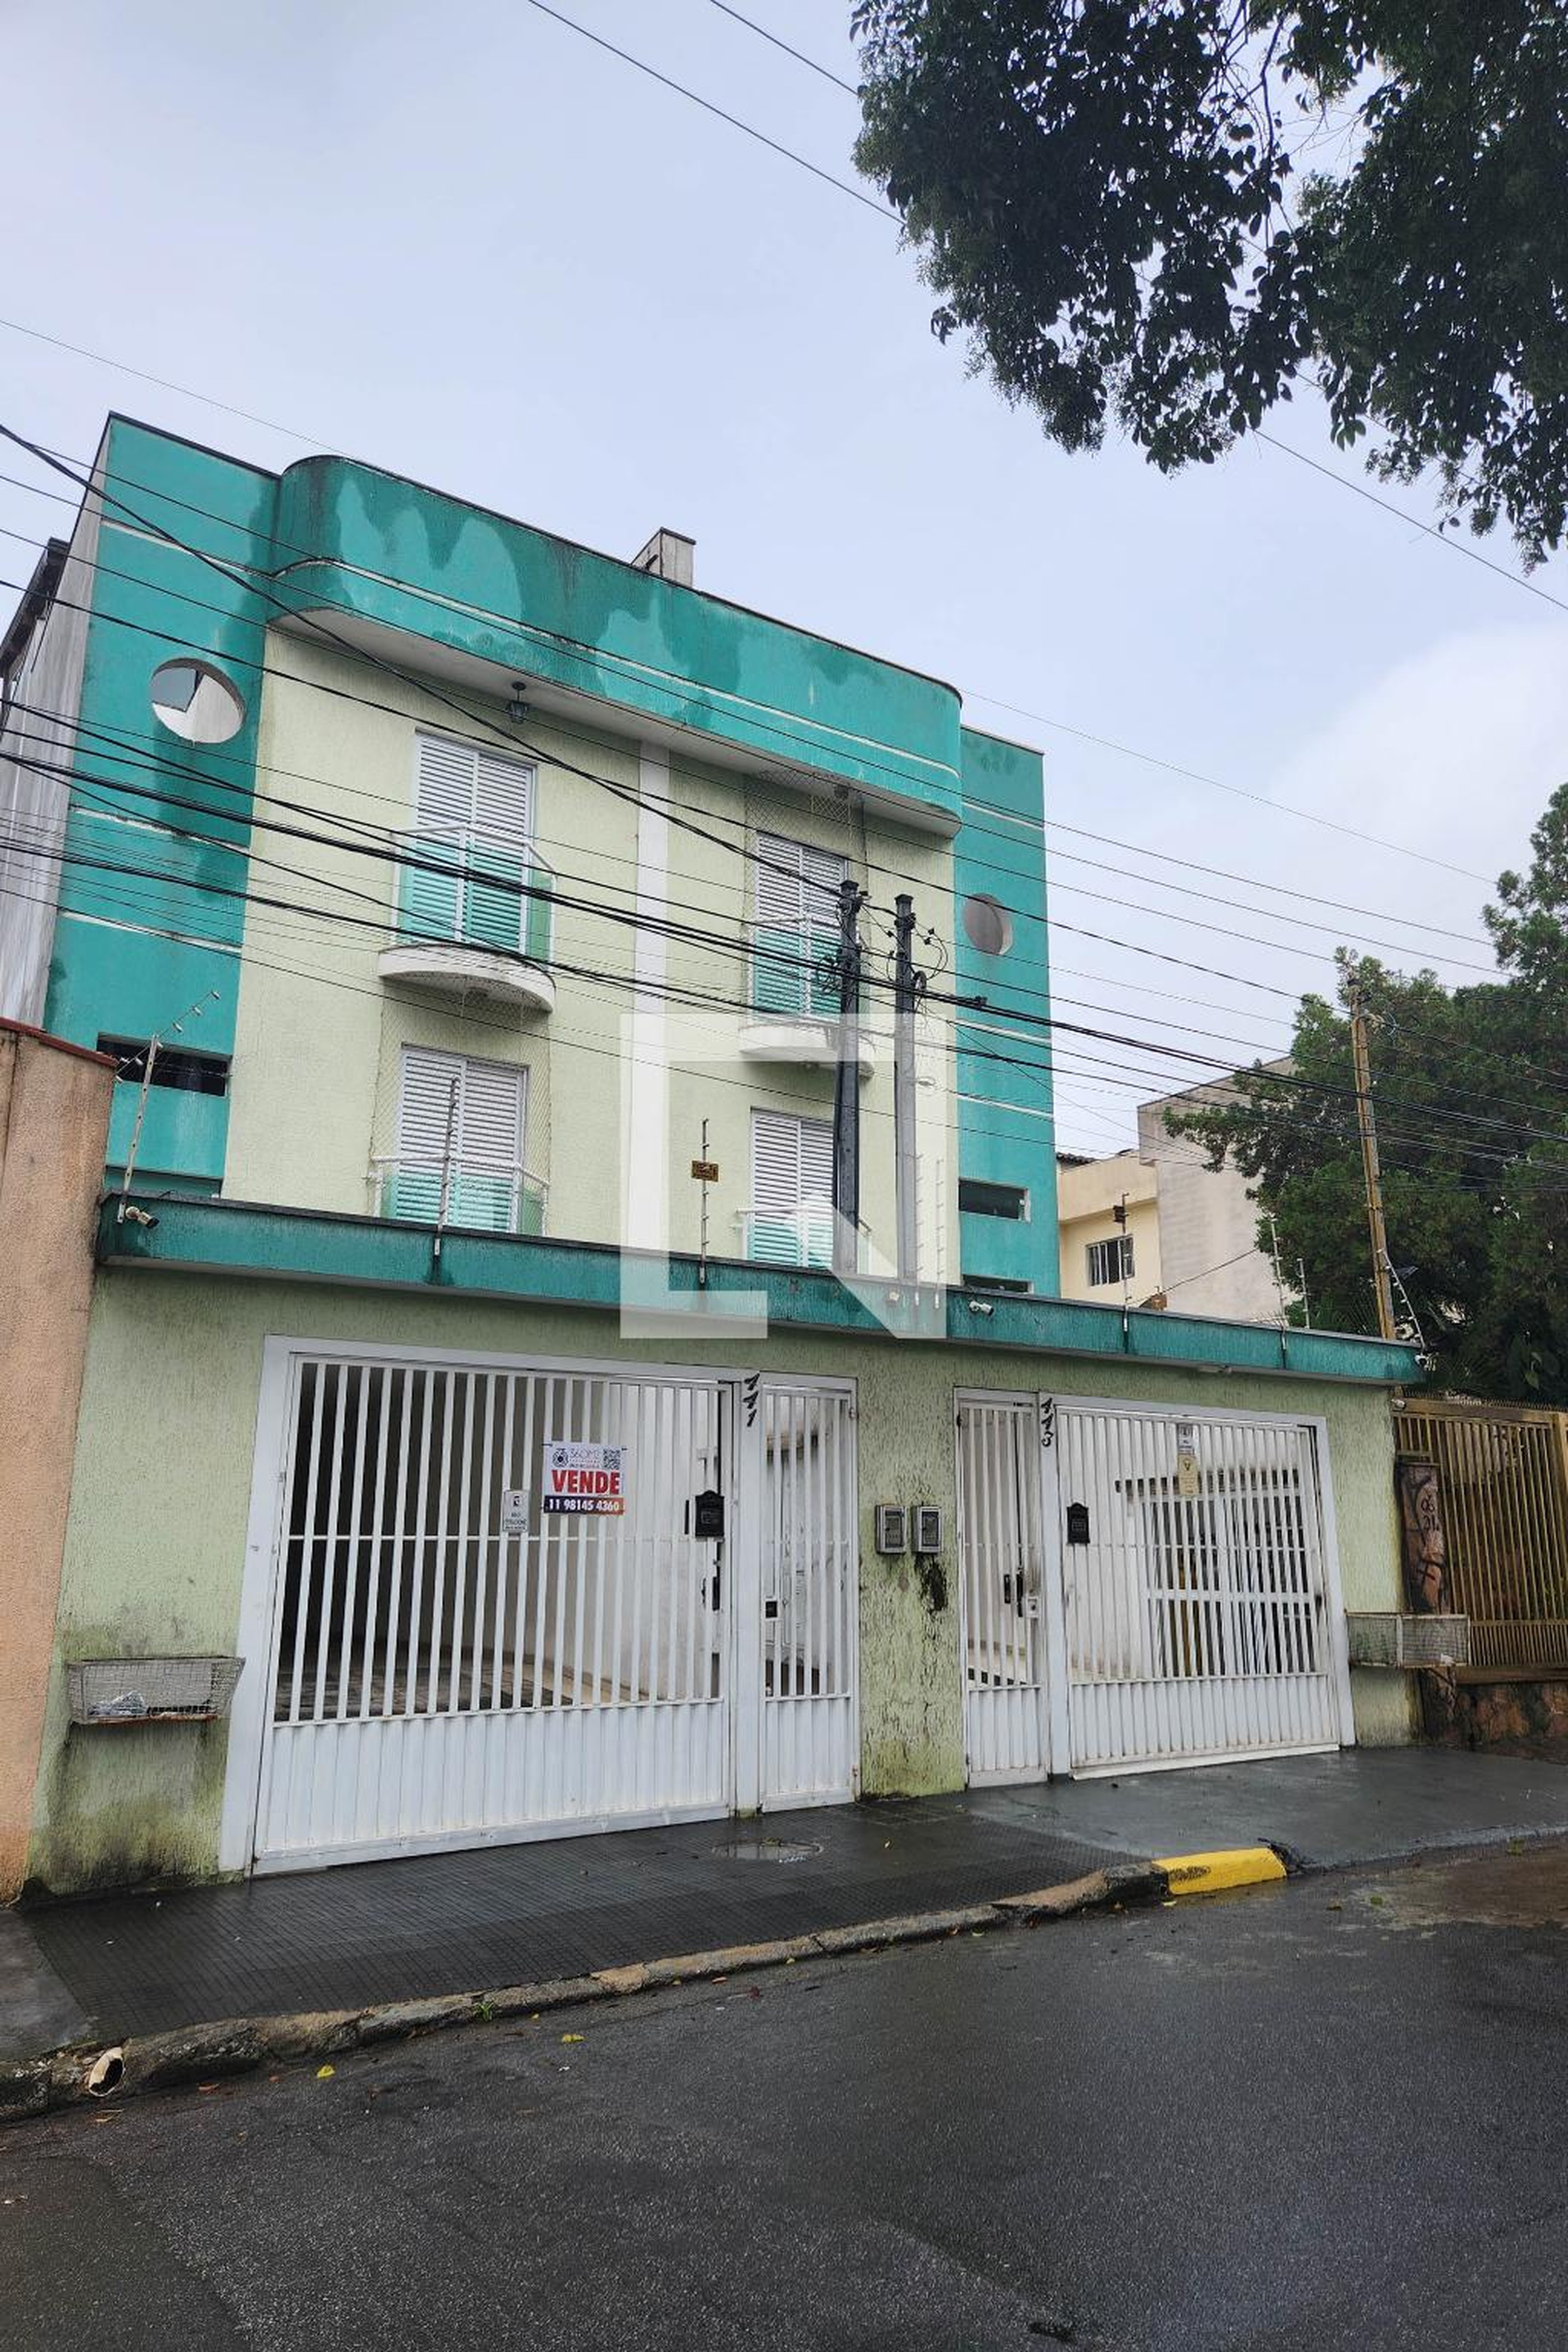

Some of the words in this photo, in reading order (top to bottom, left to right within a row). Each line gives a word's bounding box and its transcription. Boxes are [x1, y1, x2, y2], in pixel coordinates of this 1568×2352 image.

[552, 1470, 620, 1495] VENDE
[549, 1499, 560, 1510] 11
[564, 1499, 594, 1511] 98145
